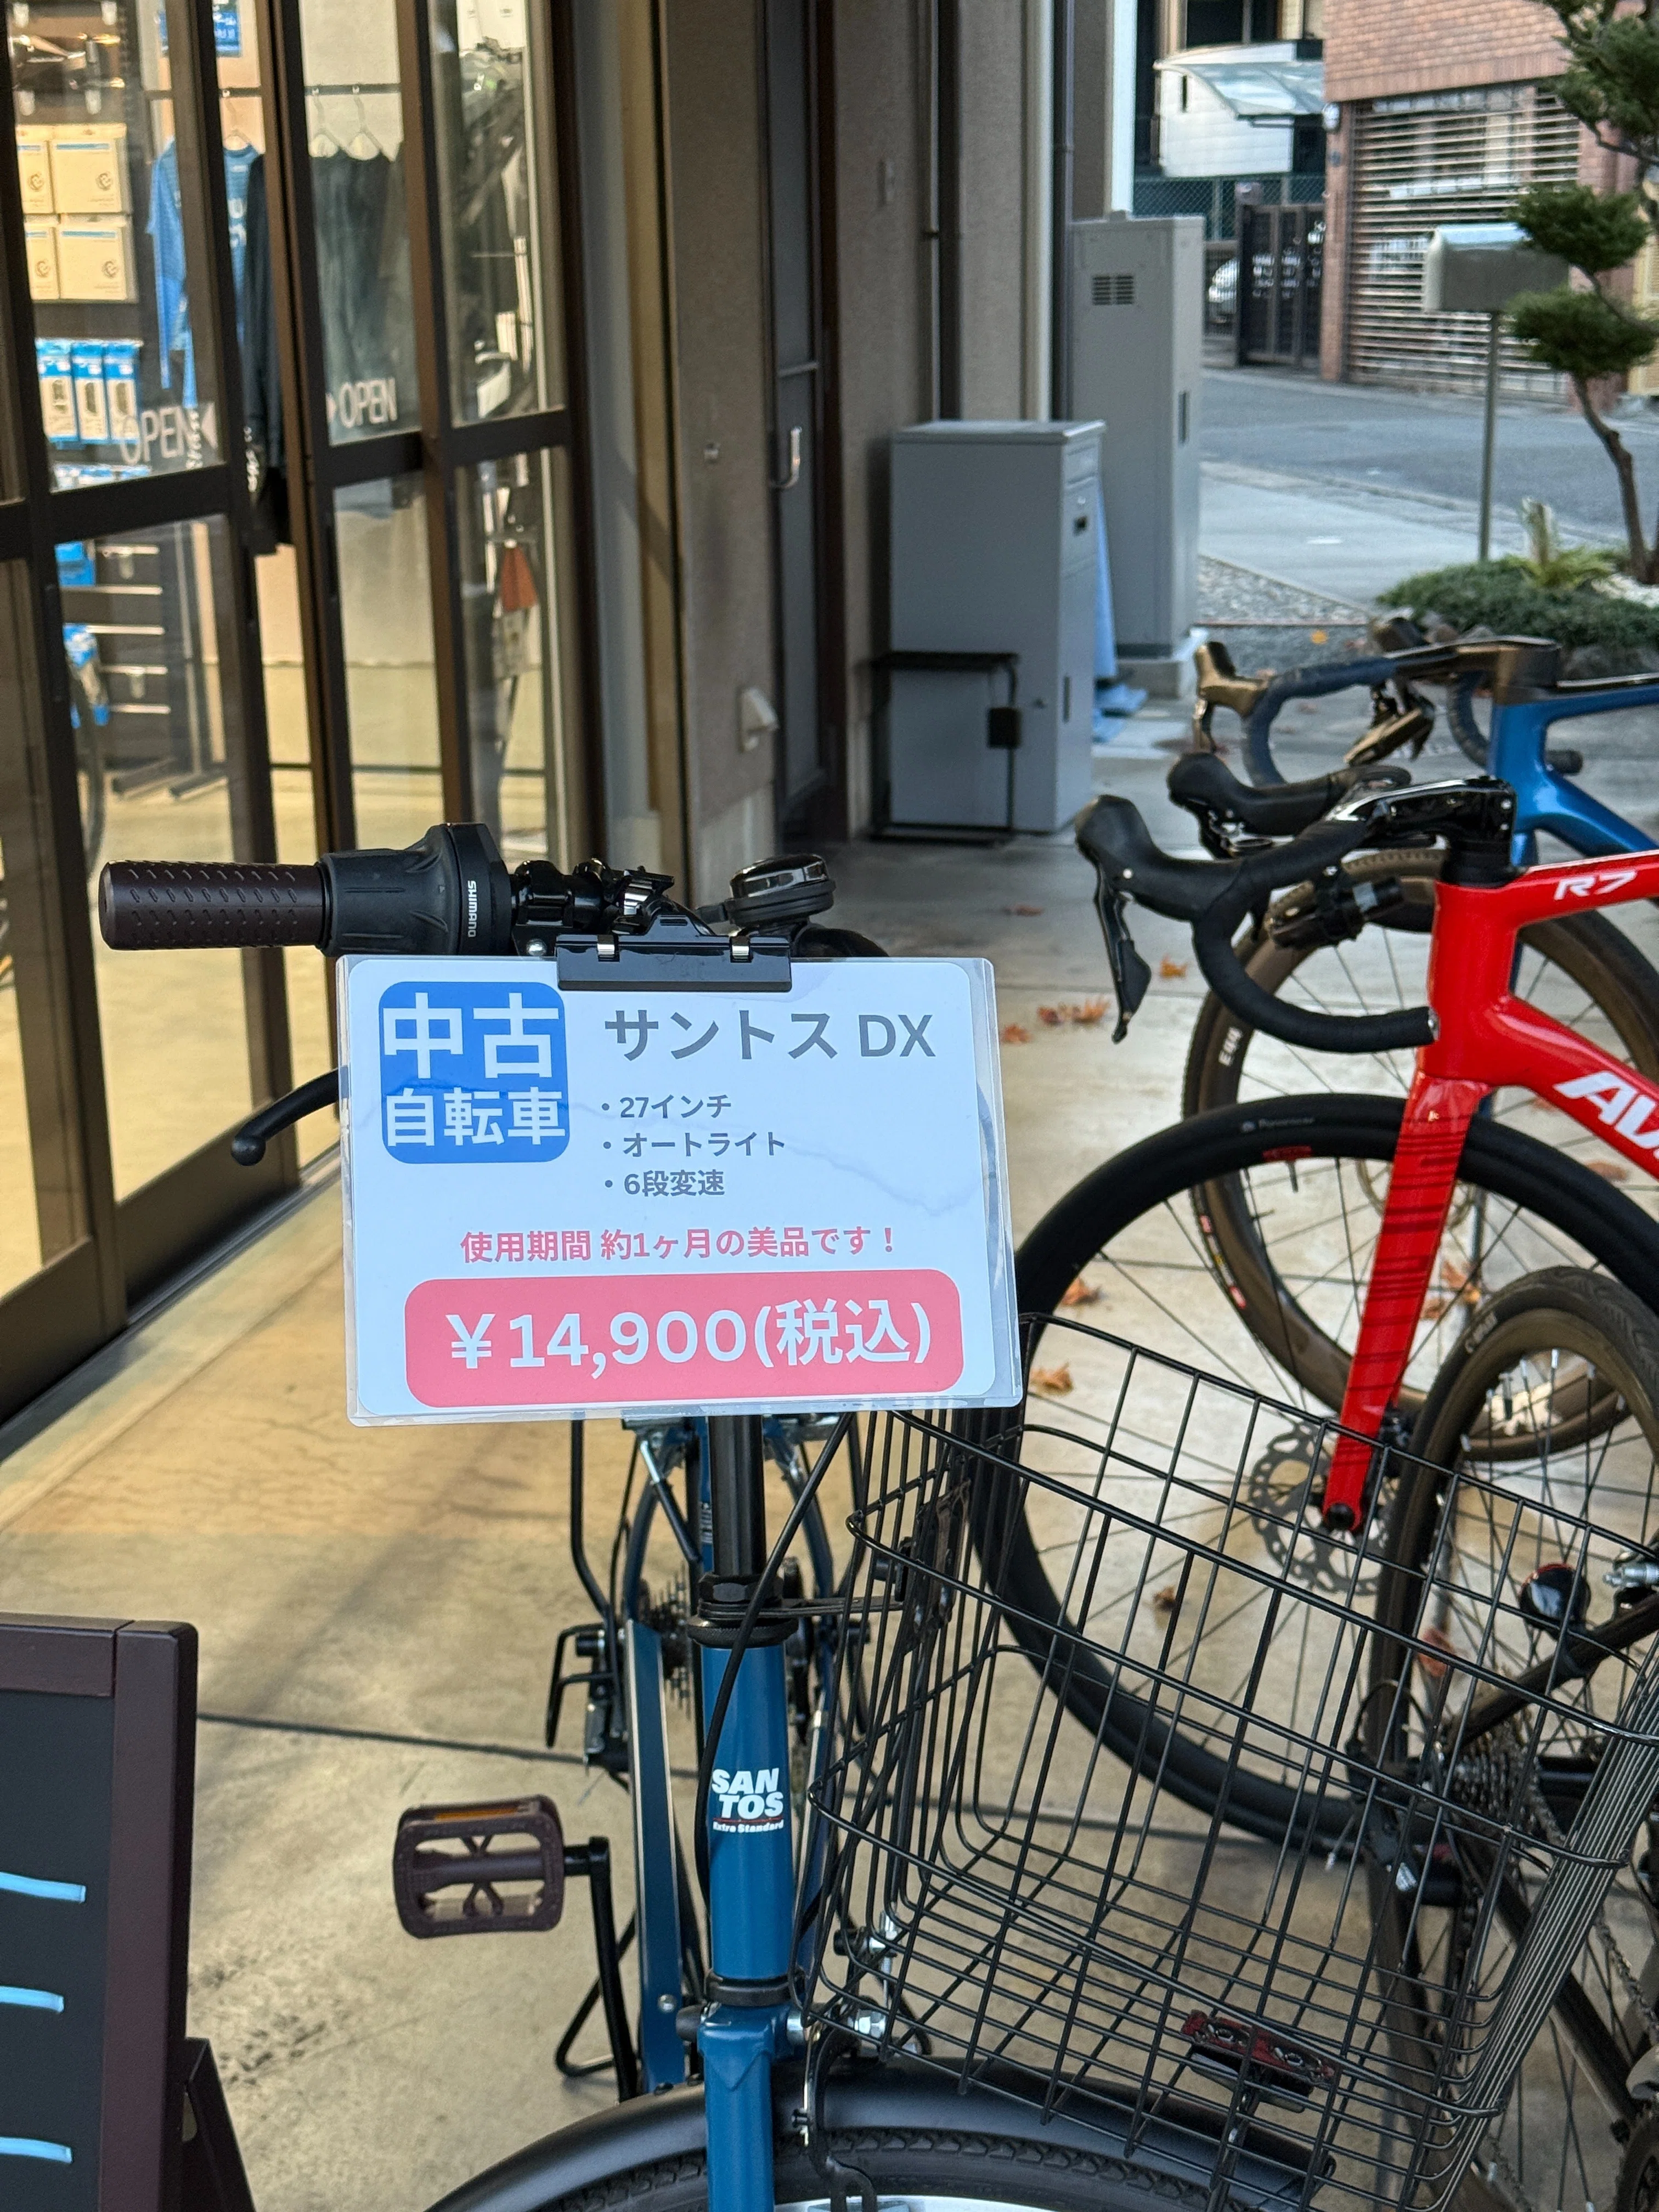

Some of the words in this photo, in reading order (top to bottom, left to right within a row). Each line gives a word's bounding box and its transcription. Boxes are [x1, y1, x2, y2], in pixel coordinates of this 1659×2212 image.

[338, 377, 398, 428] OPEN
[120, 405, 196, 465] OPEN
[467, 880, 477, 938] SHIMANO
[1554, 870, 1638, 901] R7
[383, 992, 559, 1079] 中古
[605, 1009, 838, 1062] サントス
[859, 1014, 936, 1058] DX
[386, 1086, 566, 1147] 自転車
[1552, 1070, 1659, 1160] AV
[461, 1231, 591, 1264] 使用期間
[712, 1768, 780, 1794] SAN
[719, 1791, 783, 1820] TOS
[737, 1819, 784, 1833] Standard
